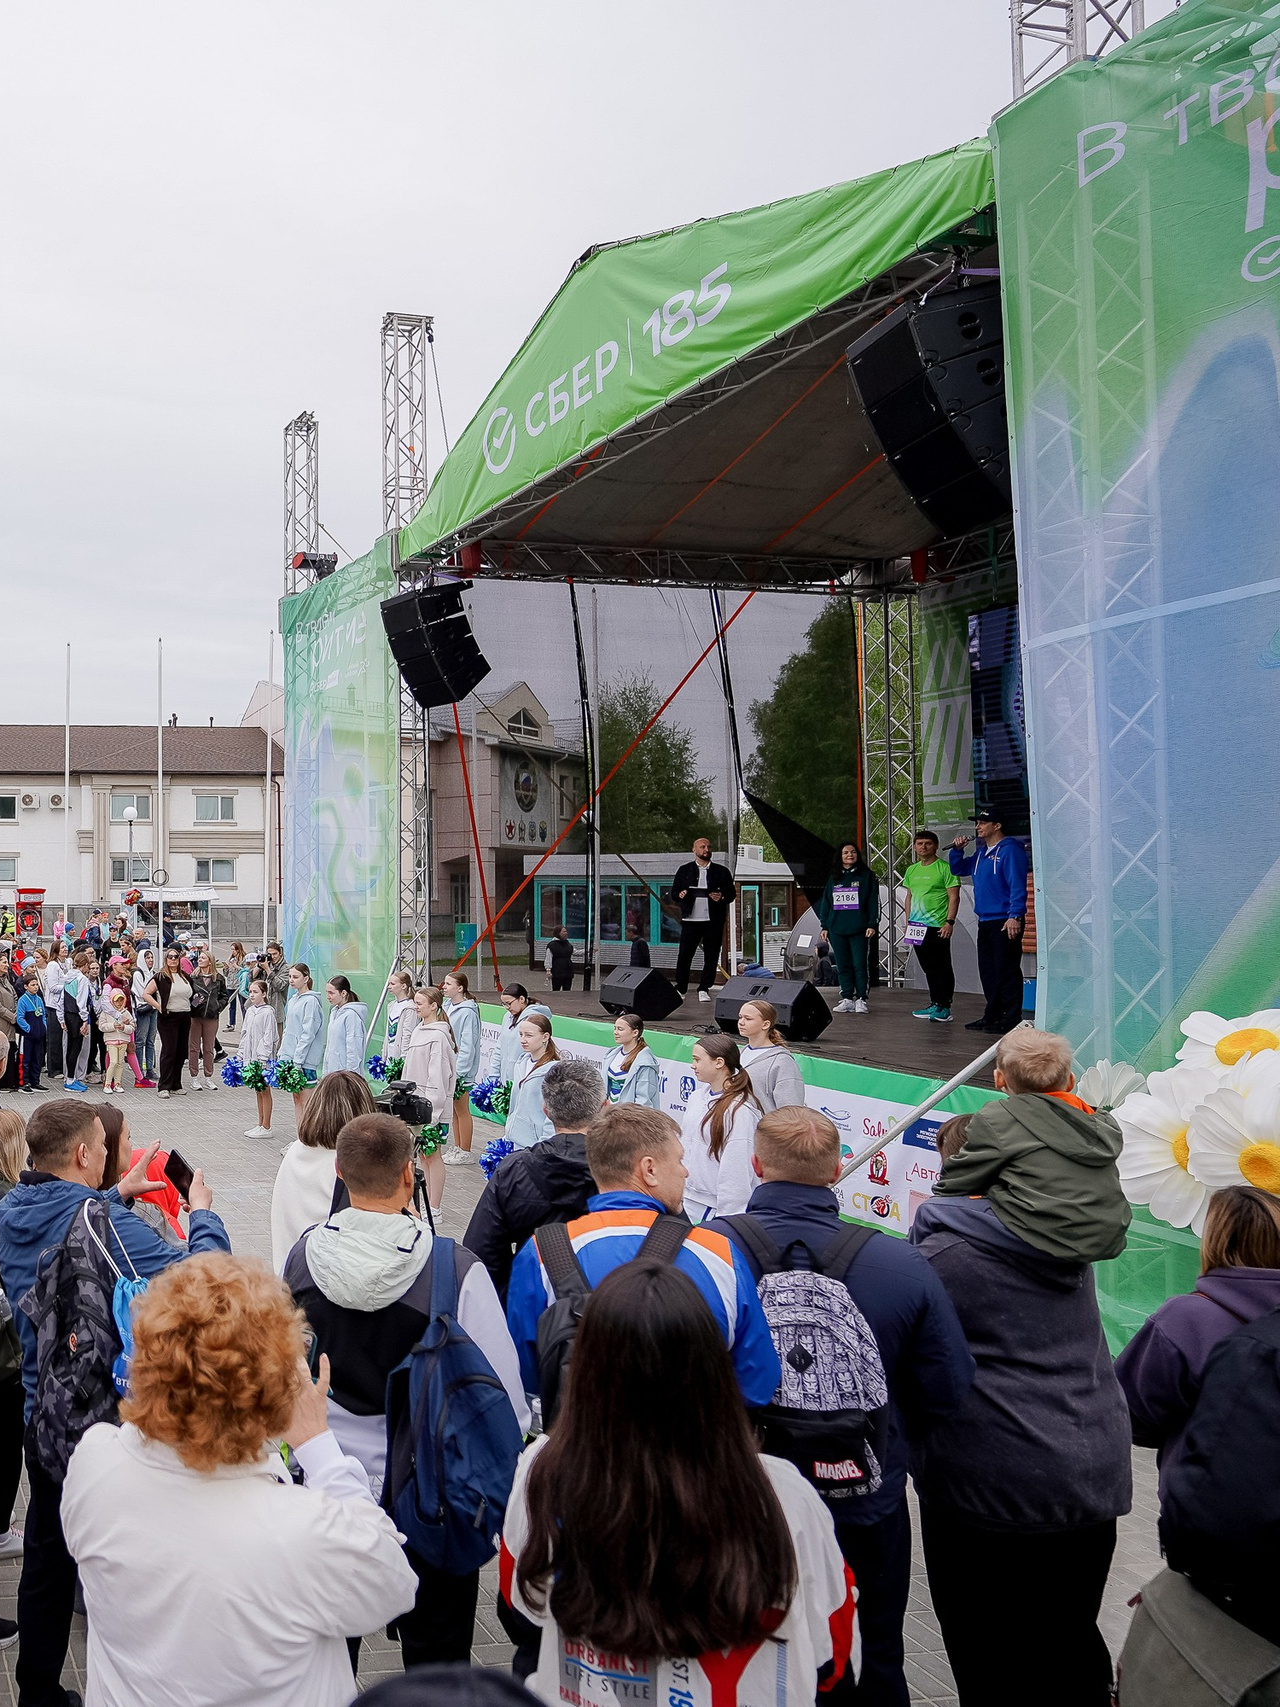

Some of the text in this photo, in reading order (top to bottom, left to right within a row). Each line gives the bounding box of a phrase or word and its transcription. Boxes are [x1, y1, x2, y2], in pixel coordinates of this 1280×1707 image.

[1076, 120, 1128, 189] В
[525, 261, 732, 438] СБЕР 185
[835, 894, 856, 902] 2186
[909, 928, 925, 937] 2185
[815, 1459, 862, 1480] MARVEL
[563, 1639, 650, 1674] URBANIST
[564, 1664, 650, 1699] LIFE STYLE
